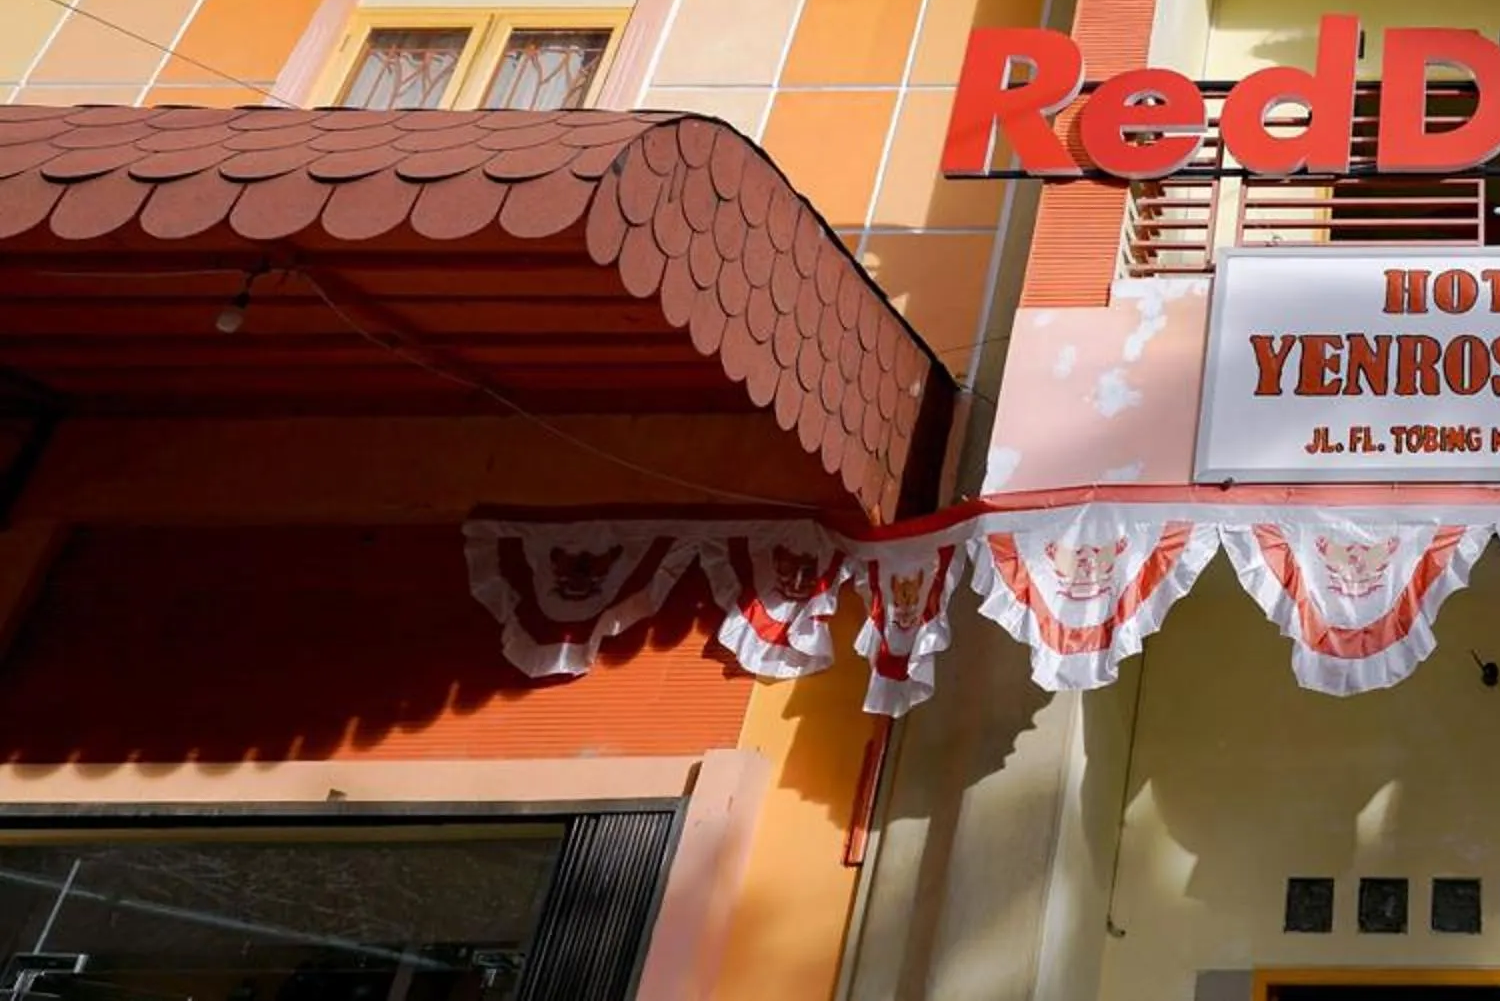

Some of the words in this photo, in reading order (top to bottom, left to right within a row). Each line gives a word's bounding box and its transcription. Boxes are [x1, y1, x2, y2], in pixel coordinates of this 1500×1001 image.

[1305, 426, 1344, 454] JL.
[1349, 426, 1385, 453] FL.
[1390, 425, 1482, 454] TOBING
